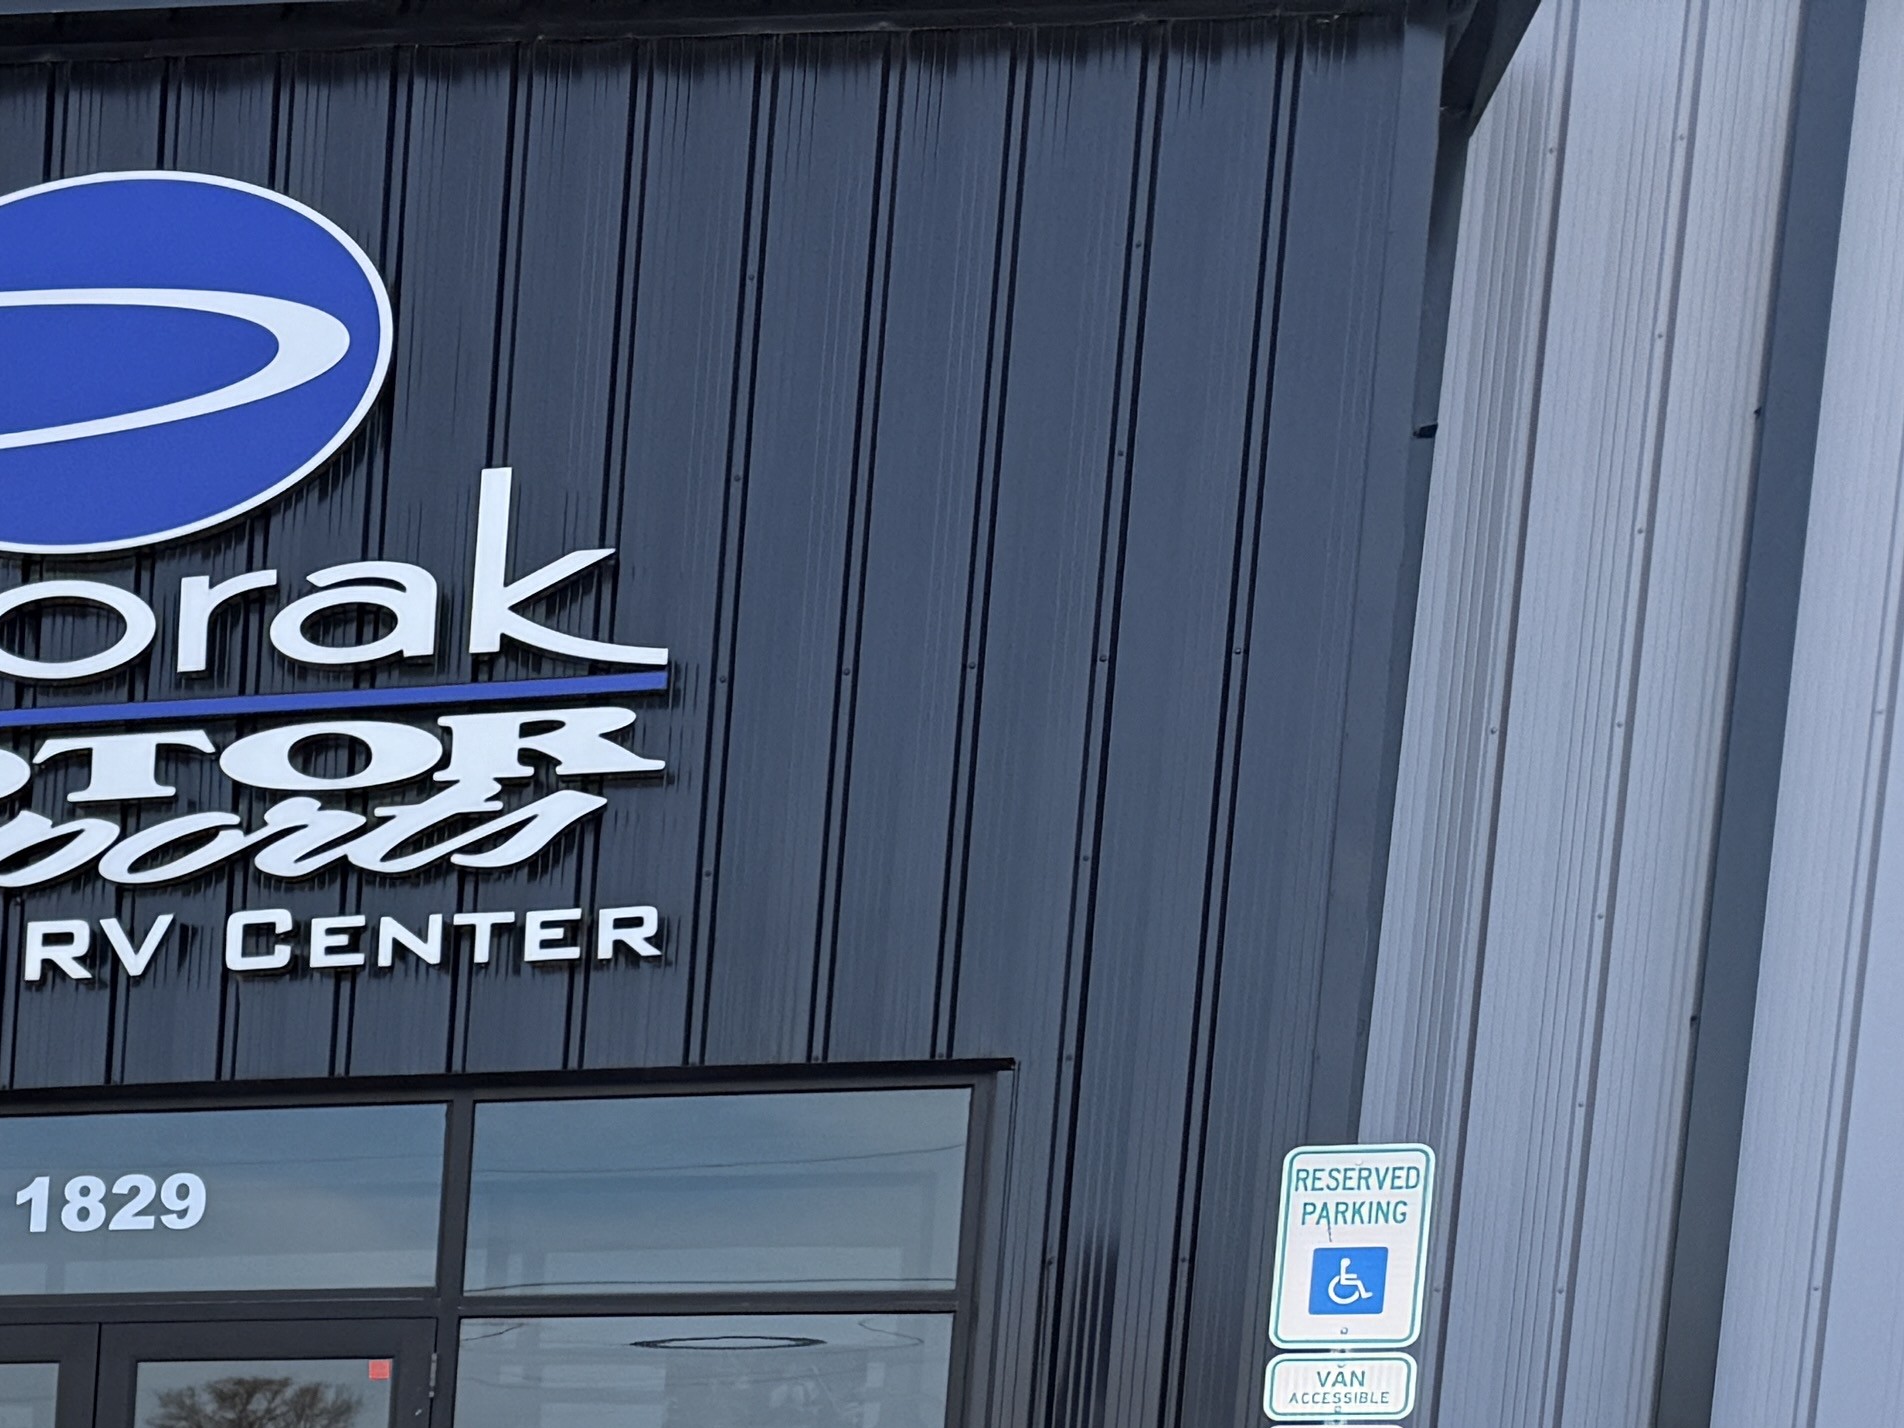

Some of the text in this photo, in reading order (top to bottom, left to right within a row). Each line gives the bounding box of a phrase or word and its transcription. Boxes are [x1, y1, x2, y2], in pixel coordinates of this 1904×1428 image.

[24, 915, 175, 983] RV
[225, 906, 661, 972] CENTER
[1295, 1166, 1420, 1192] RESERVED
[16, 1172, 206, 1232] 1829
[1301, 1200, 1408, 1226] PARKING
[1316, 1370, 1365, 1388] VAN
[1289, 1391, 1389, 1405] ACCESSIBLE
